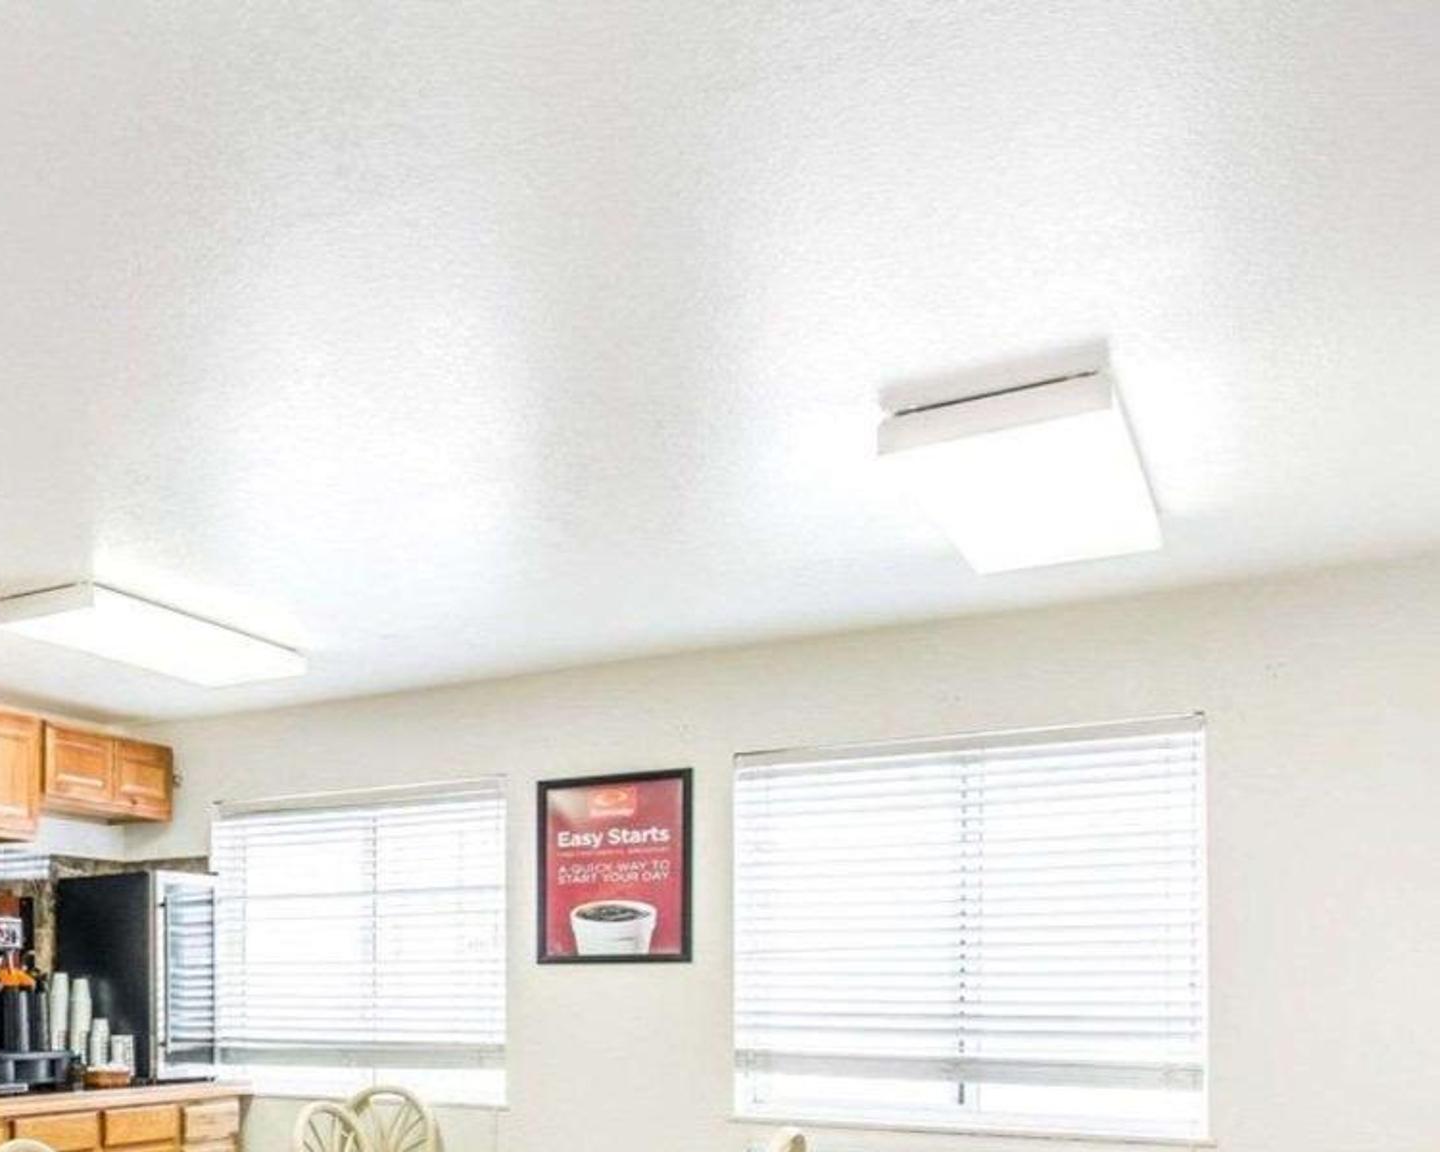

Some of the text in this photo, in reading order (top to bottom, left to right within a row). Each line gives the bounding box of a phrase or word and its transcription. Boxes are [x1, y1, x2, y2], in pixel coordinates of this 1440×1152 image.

[557, 827, 671, 848] Easy Starts
[558, 859, 671, 874] A QUICK WAY TO
[558, 871, 669, 885] START YOUR DAY
